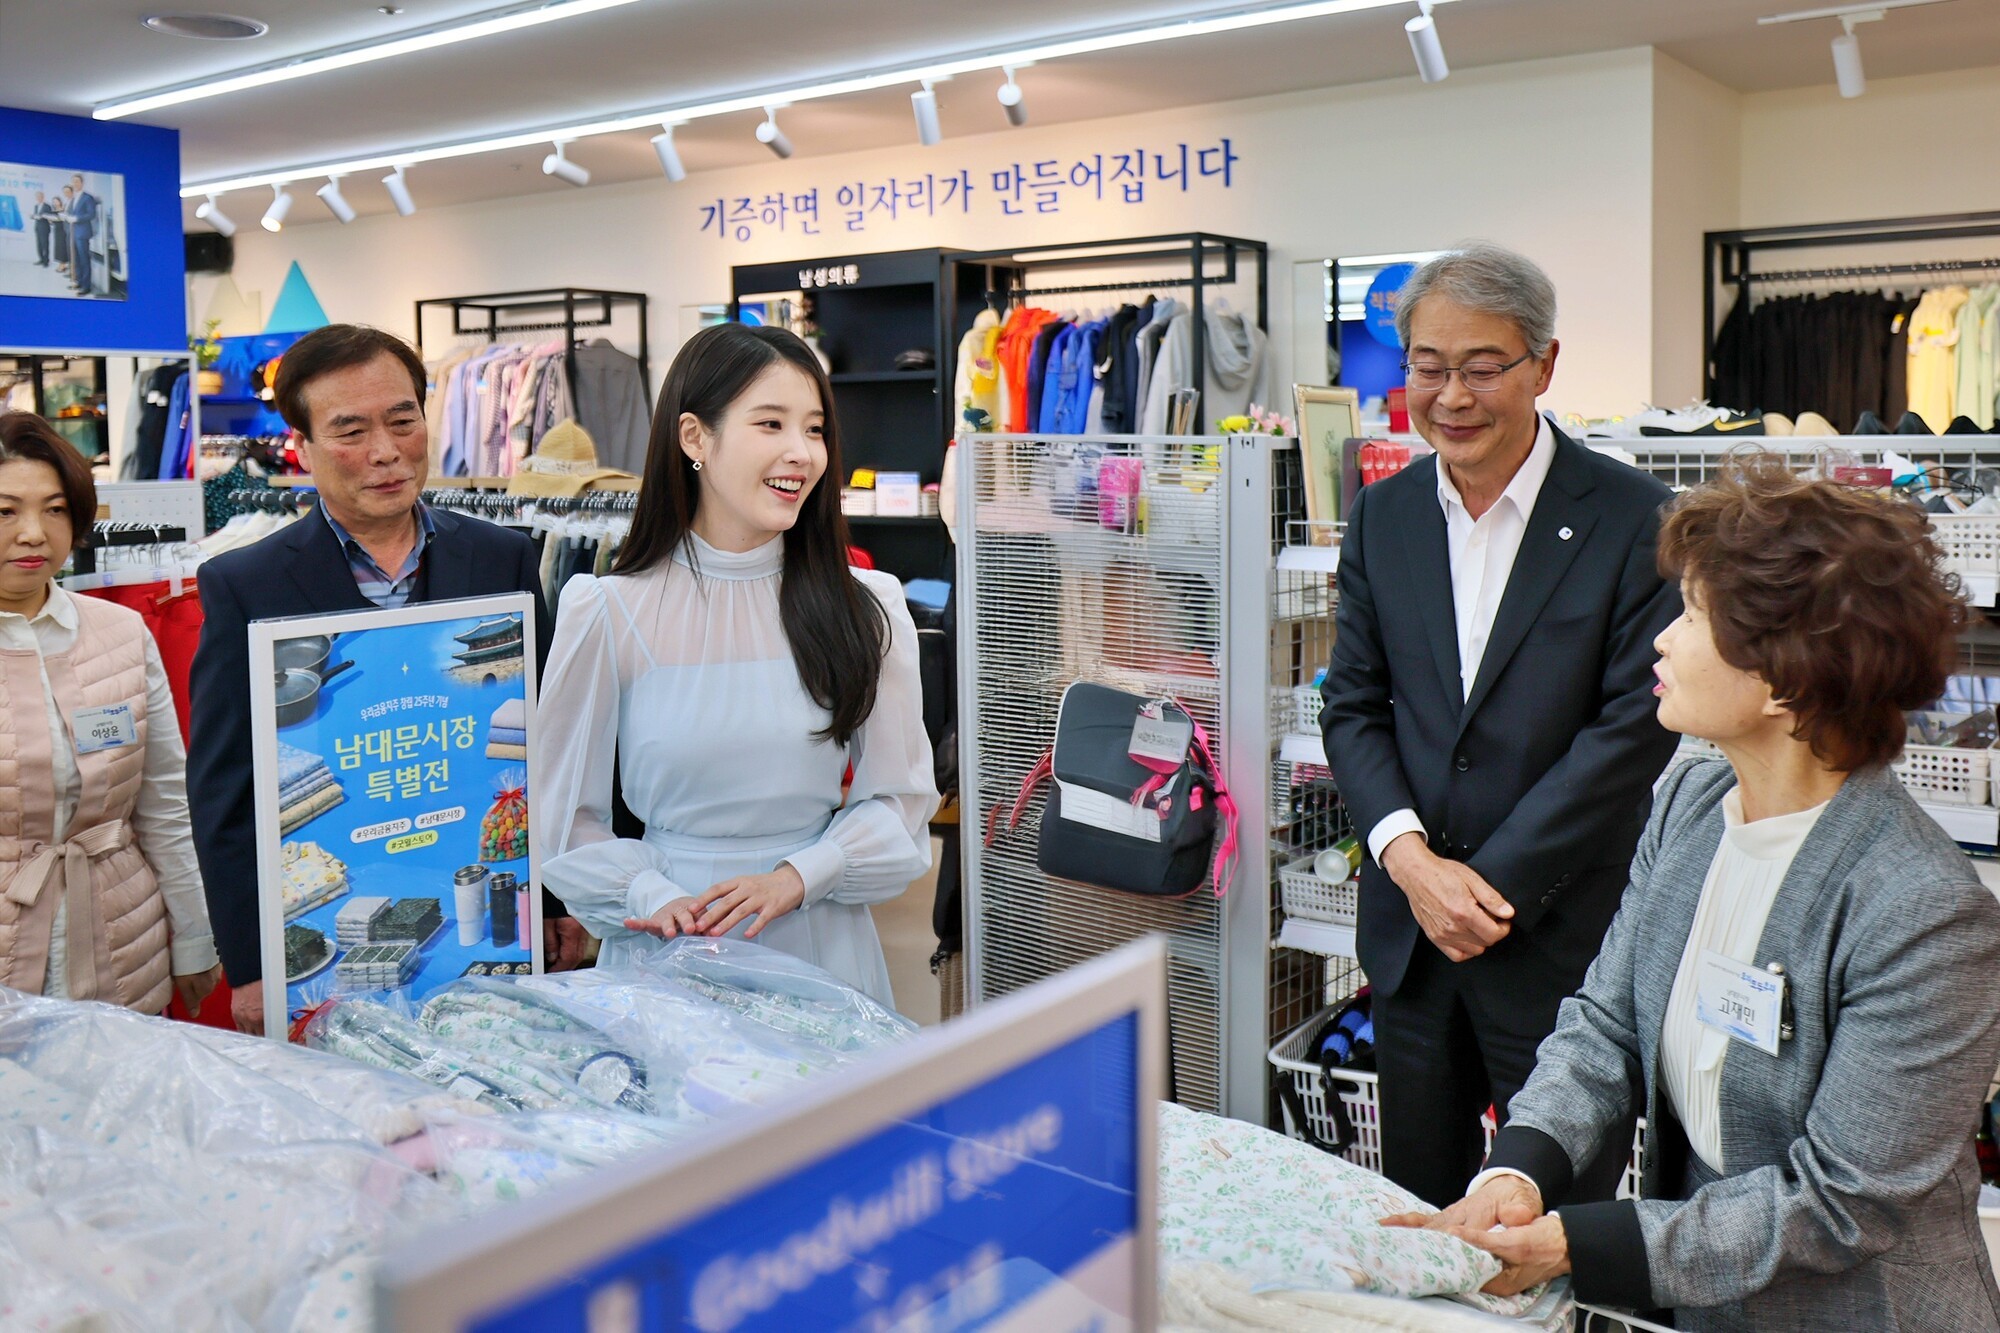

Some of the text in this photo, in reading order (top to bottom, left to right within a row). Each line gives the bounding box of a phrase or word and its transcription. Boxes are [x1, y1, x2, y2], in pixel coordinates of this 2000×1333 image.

[700, 138, 1239, 242] 기증하면 일자리가 만들어집니다
[798, 264, 859, 289] 남성의류
[360, 695, 449, 721] 우리금융지주 창립 25주년 기념
[91, 725, 119, 739] 이상윤
[335, 714, 477, 771] 남대문시장
[365, 758, 449, 803] 특별전
[356, 809, 461, 839] #우리금융지주 #남대문시장
[391, 832, 434, 850] #굿윌스토어
[1718, 996, 1756, 1027] 고재민
[689, 1152, 943, 1333] Goodwill
